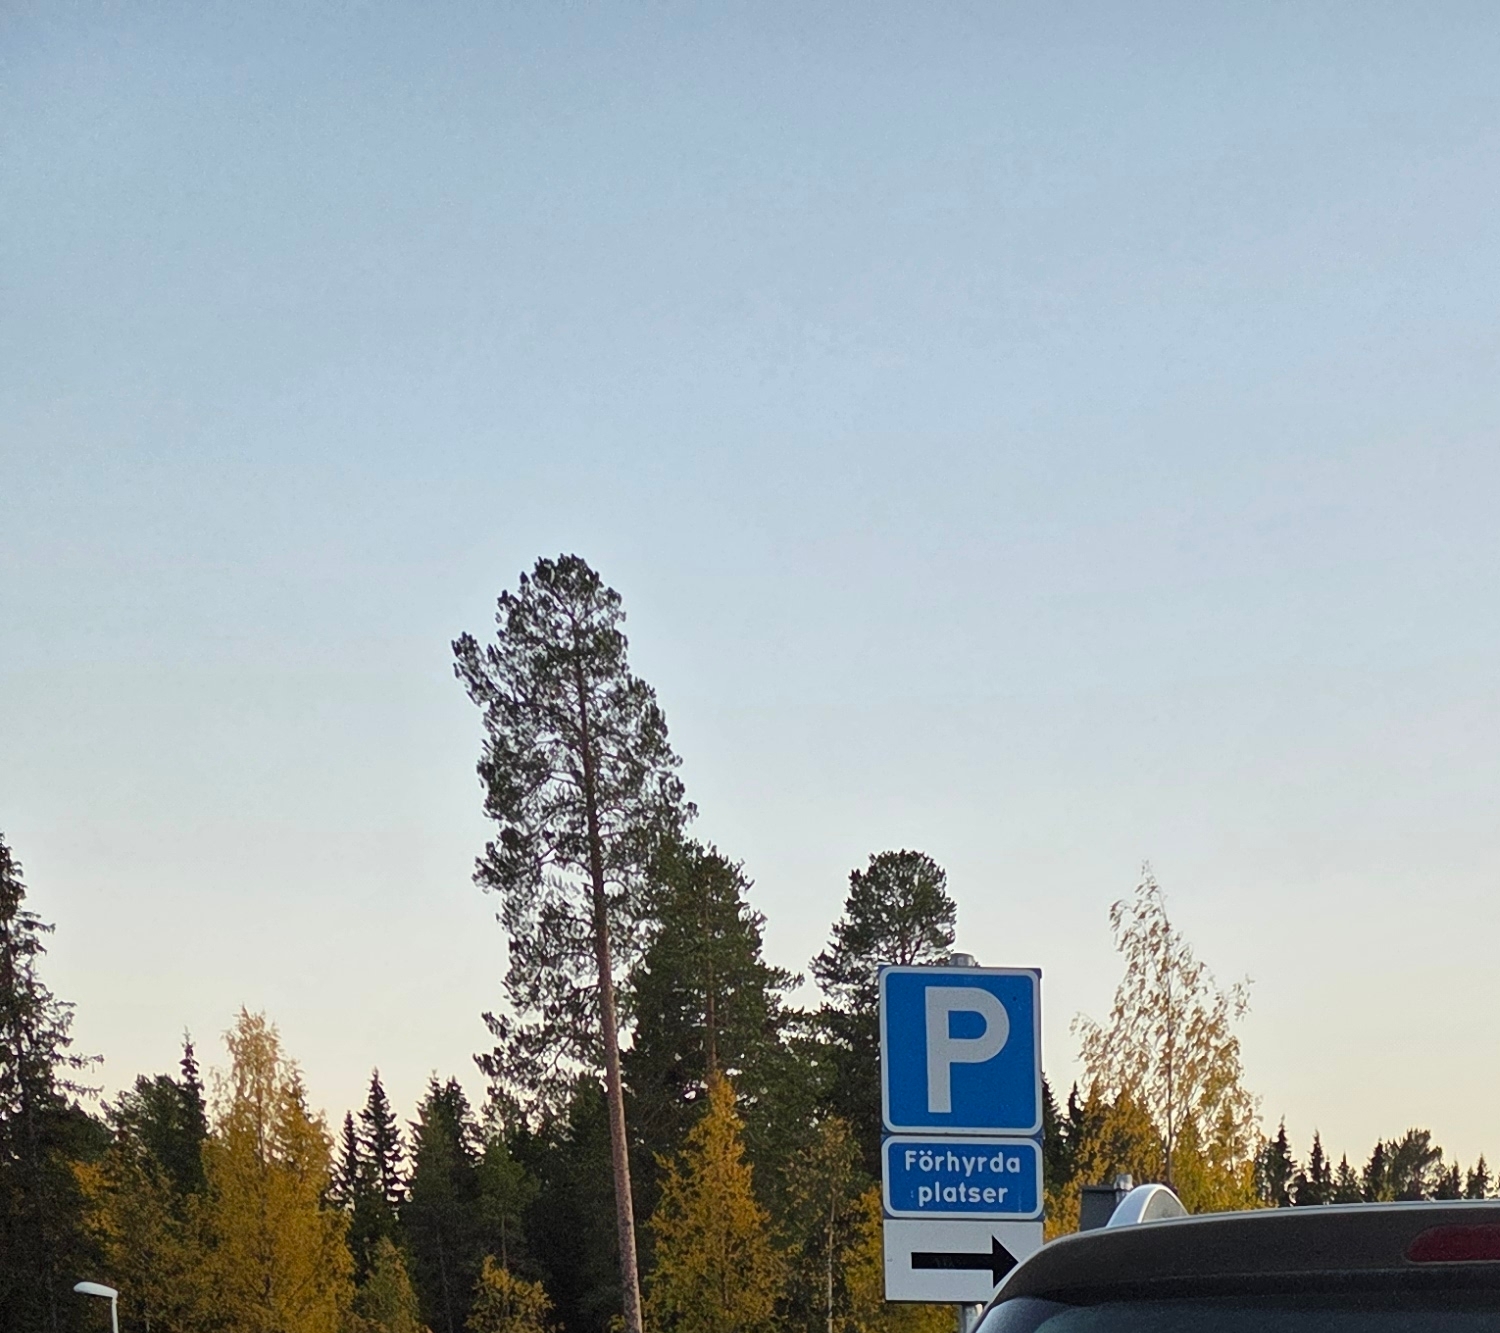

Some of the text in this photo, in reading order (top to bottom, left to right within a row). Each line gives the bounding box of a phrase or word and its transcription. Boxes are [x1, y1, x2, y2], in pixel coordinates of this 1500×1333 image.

[924, 985, 1010, 1114] P
[904, 1149, 1021, 1178] Förhyrda
[918, 1180, 1009, 1208] platser
